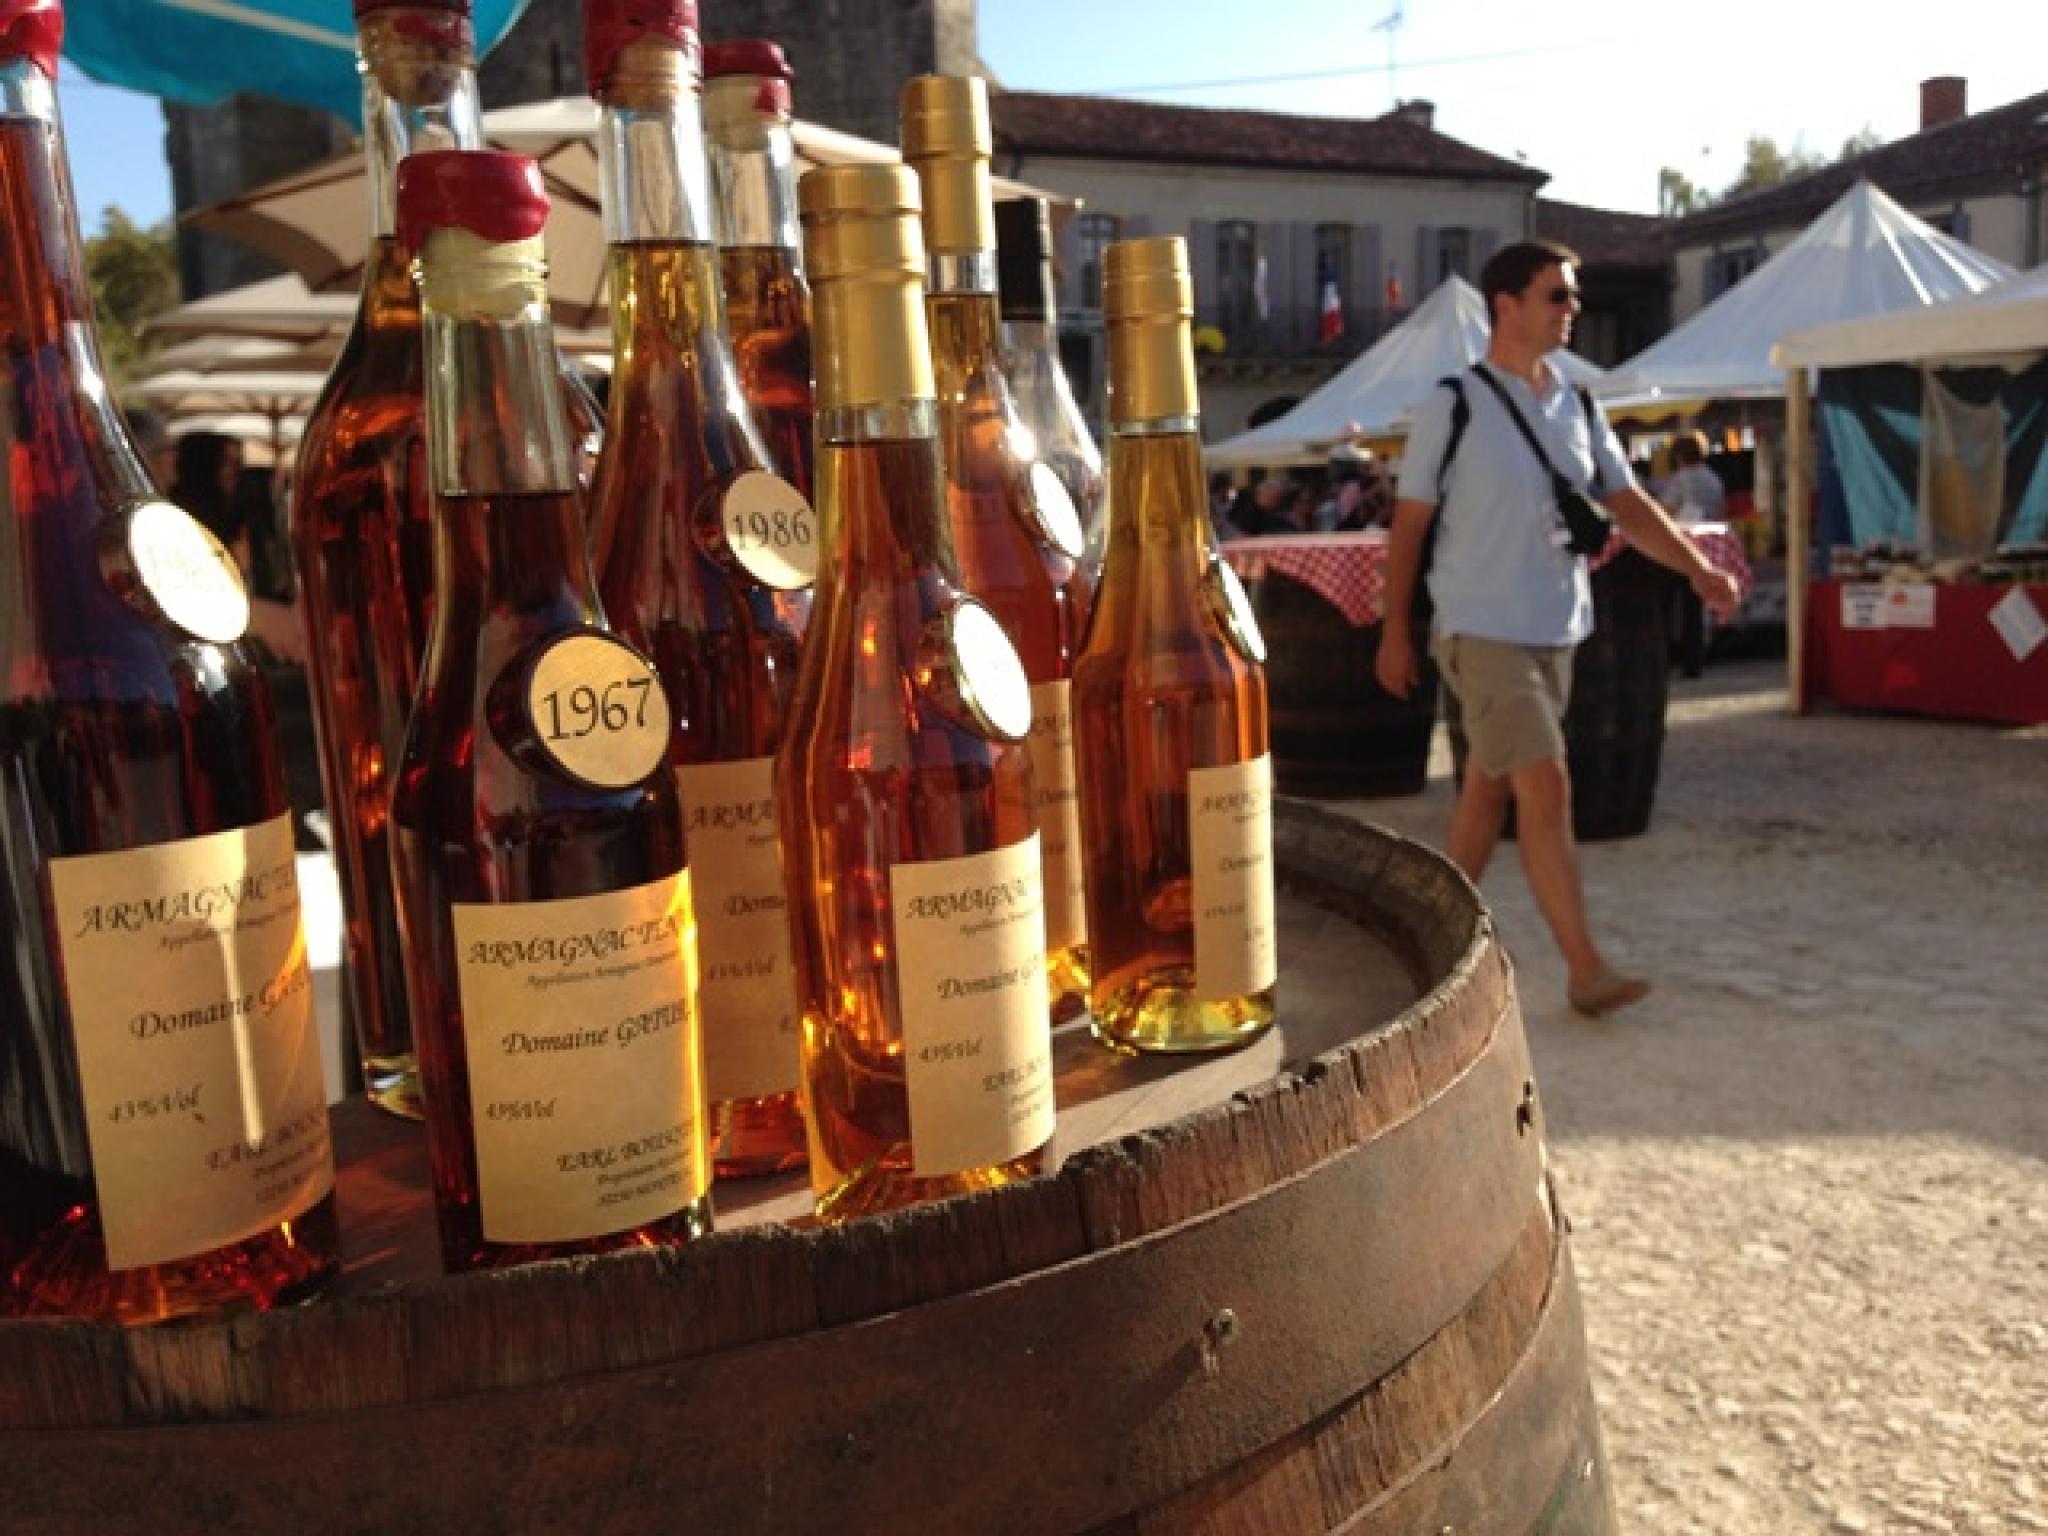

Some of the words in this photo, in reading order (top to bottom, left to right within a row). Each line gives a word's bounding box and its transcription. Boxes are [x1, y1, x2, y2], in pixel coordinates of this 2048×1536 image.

[732, 509, 811, 549] 1986
[543, 677, 651, 740] 1967
[77, 877, 268, 938] ARMAGNAC
[466, 925, 636, 968] ARMAGNAC
[938, 970, 1018, 999] Domaine
[131, 990, 255, 1040] Domaine
[501, 1025, 611, 1056] Domaine
[556, 1145, 619, 1173] EARL
